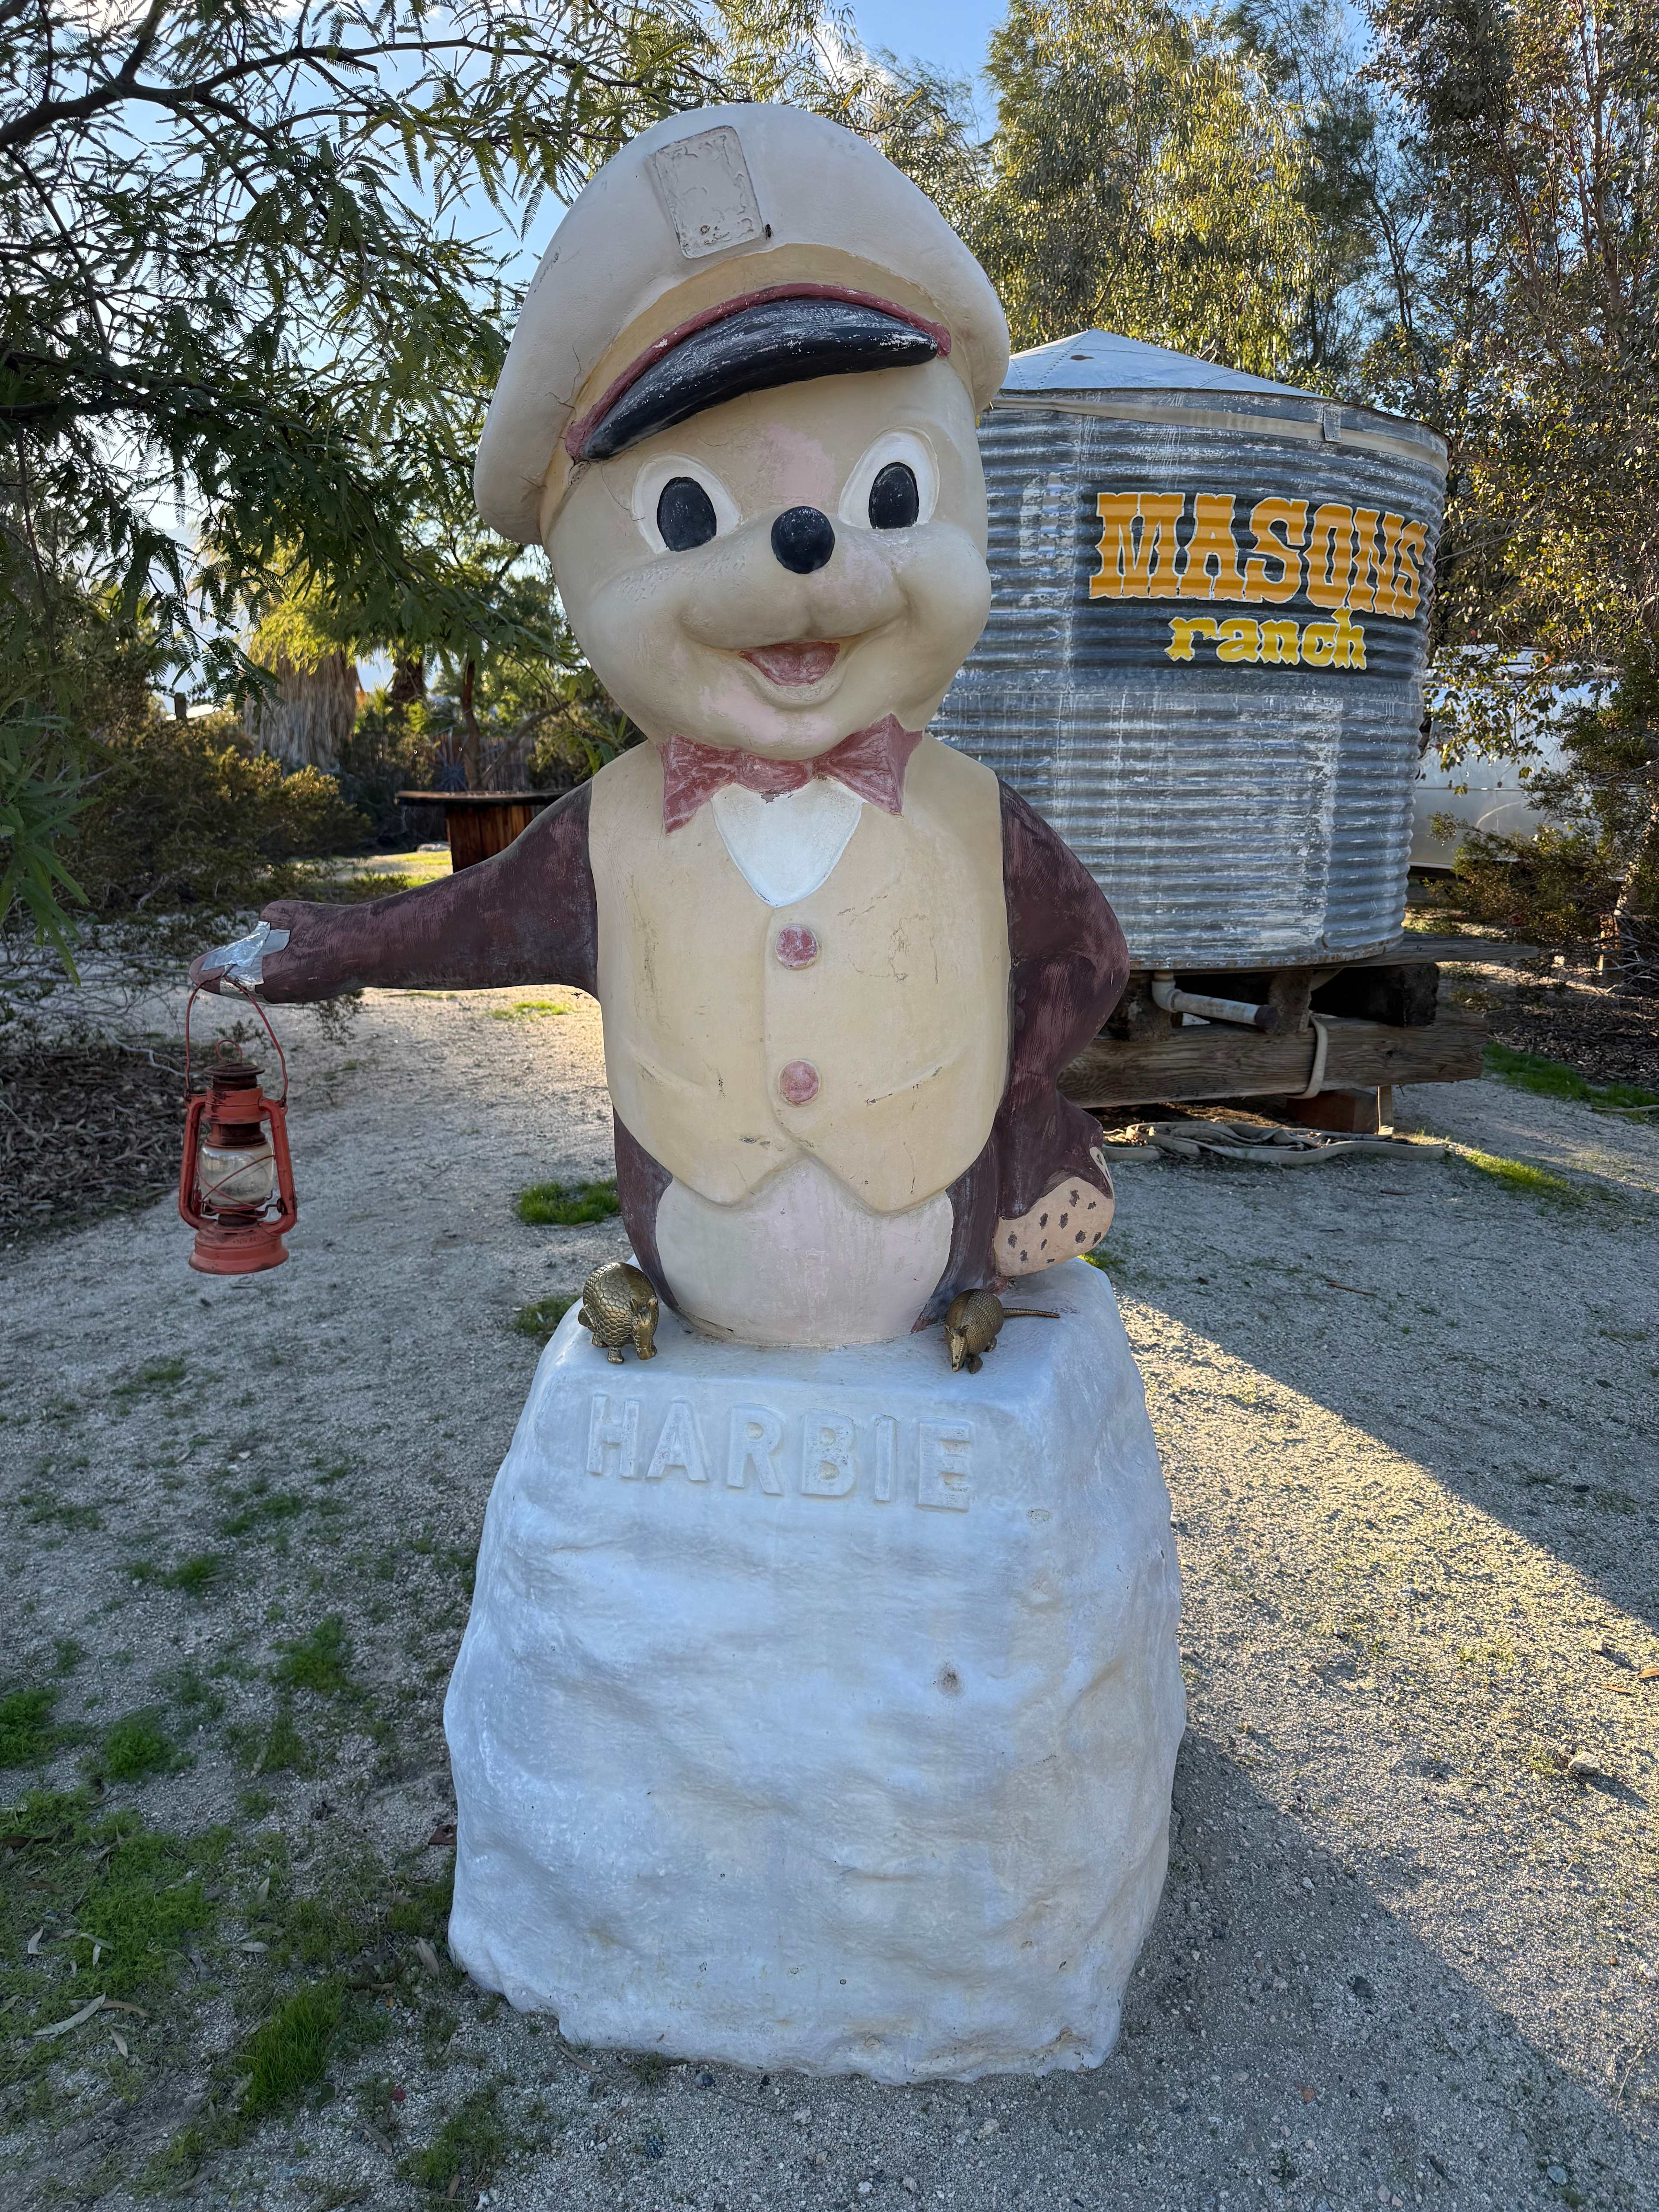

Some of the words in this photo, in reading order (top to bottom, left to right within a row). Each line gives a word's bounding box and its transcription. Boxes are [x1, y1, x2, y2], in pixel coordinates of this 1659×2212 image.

[1089, 491, 1428, 620] MASONS
[1163, 605, 1367, 671] ranch
[586, 1393, 971, 1513] HARBIE
